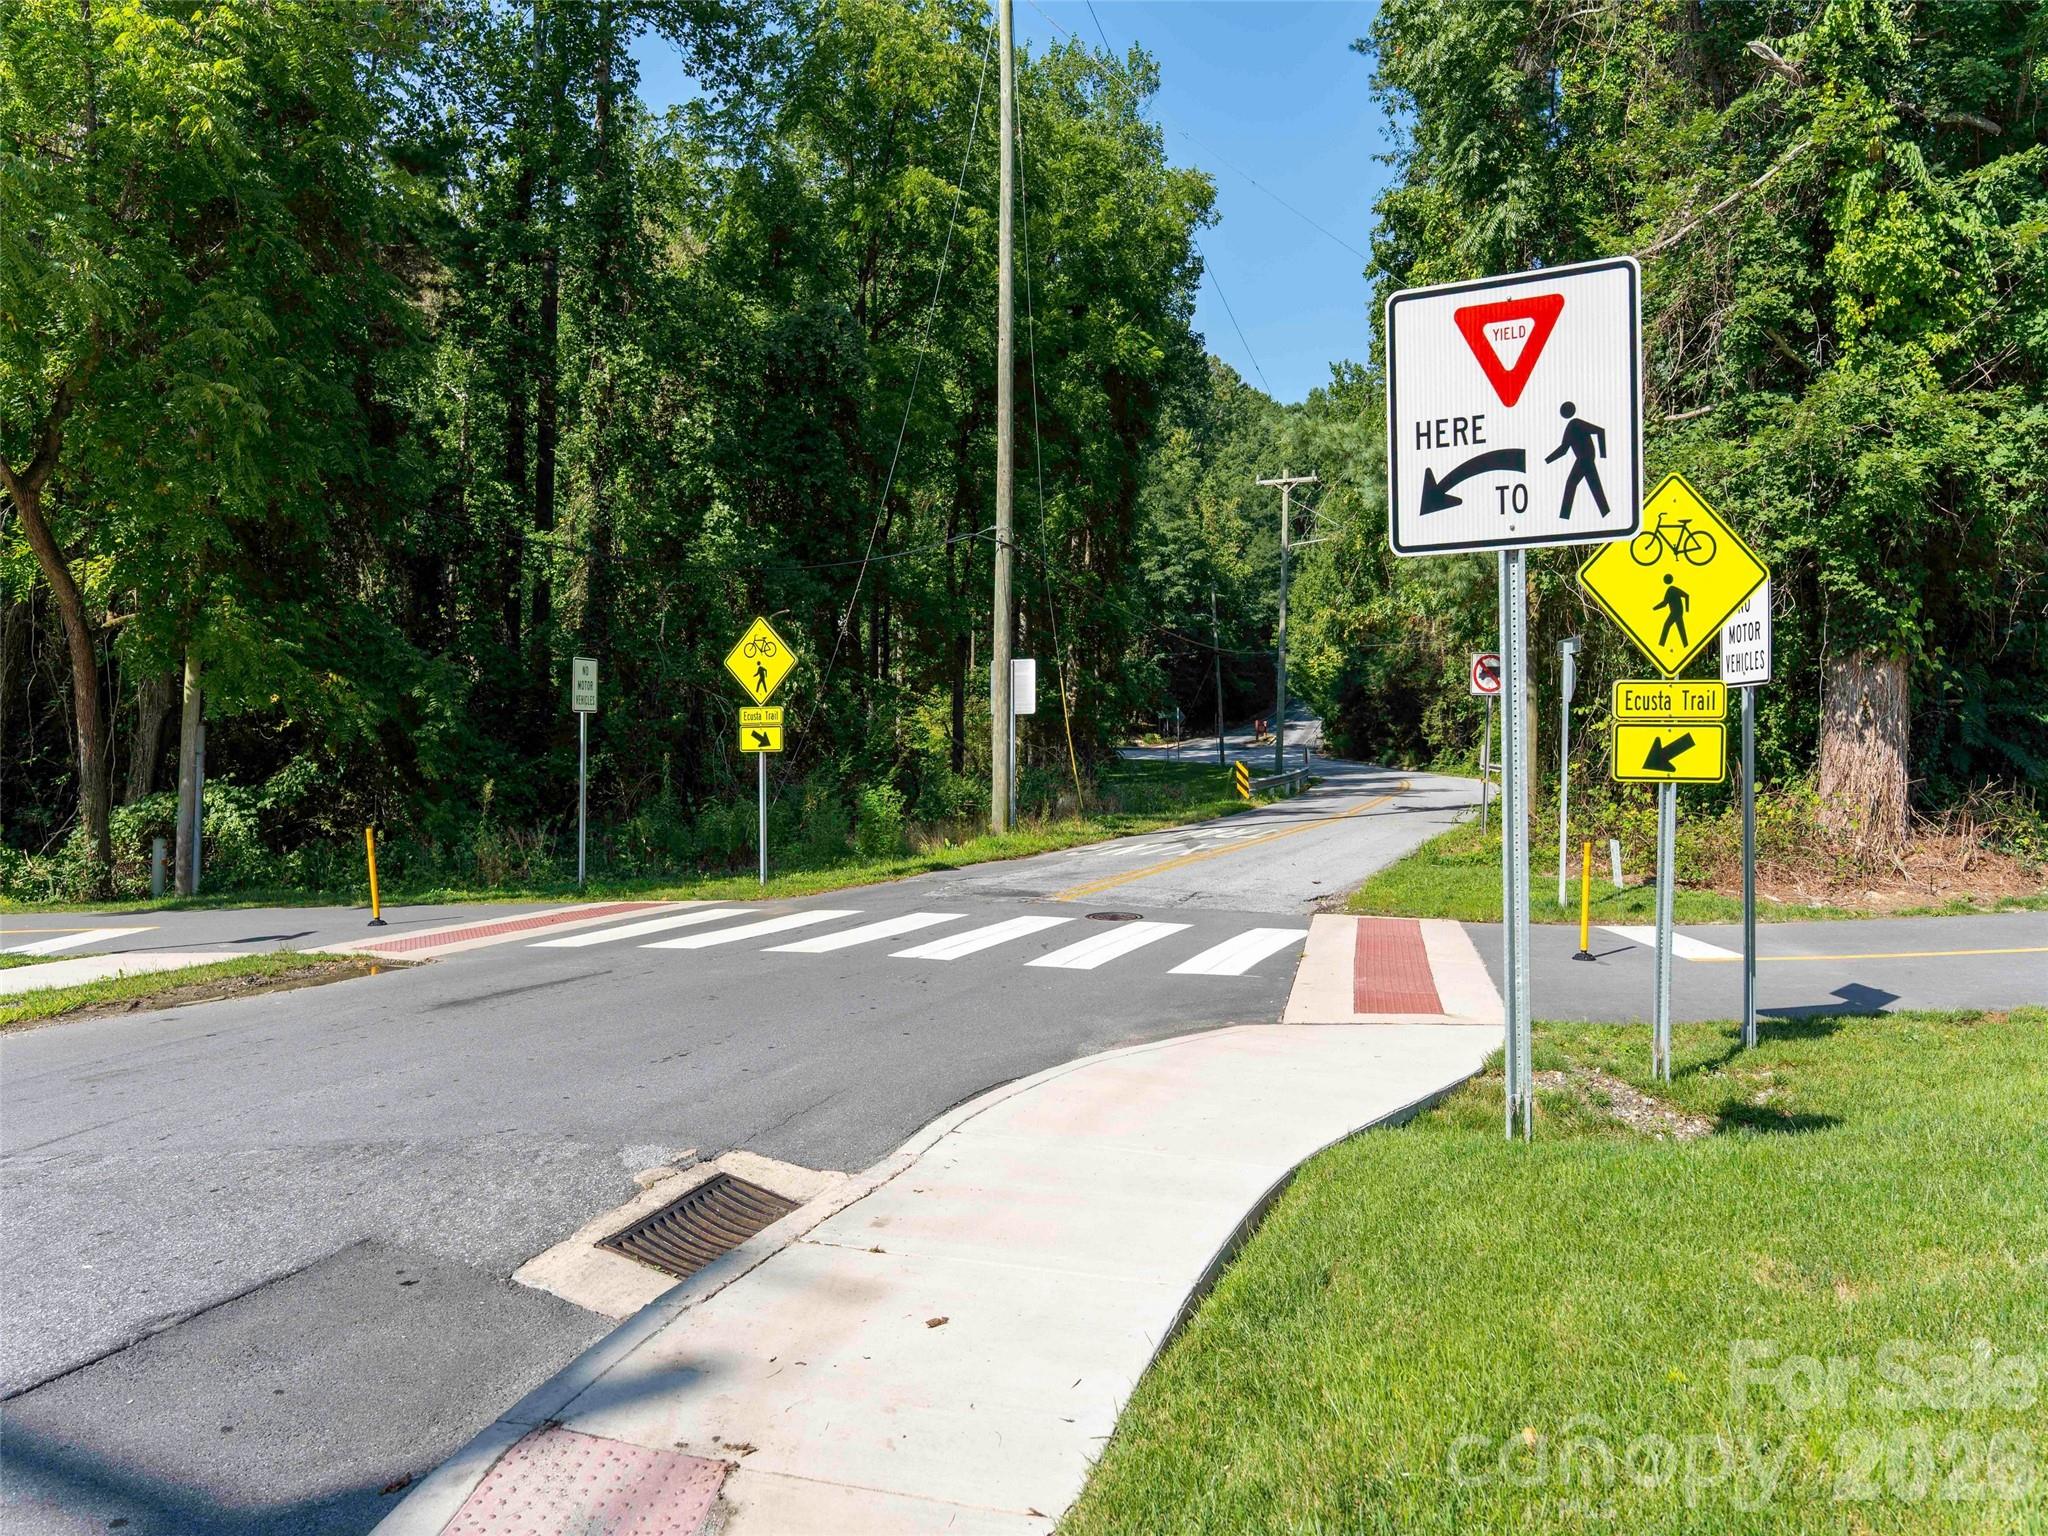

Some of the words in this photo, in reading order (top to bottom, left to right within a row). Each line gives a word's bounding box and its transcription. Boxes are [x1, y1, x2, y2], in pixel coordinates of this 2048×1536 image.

[1492, 325, 1527, 342] YIELD
[1415, 414, 1487, 451] HERE
[1495, 483, 1529, 515] TO
[1737, 598, 1751, 614] O
[1728, 620, 1761, 645] MOTOR
[1725, 649, 1765, 673] VEHICLES
[577, 679, 594, 691] MOTOR
[1625, 689, 1672, 711] Ecusta
[1682, 689, 1716, 711] Trail
[743, 711, 762, 721] Ecusta
[765, 710, 779, 721] Trail
